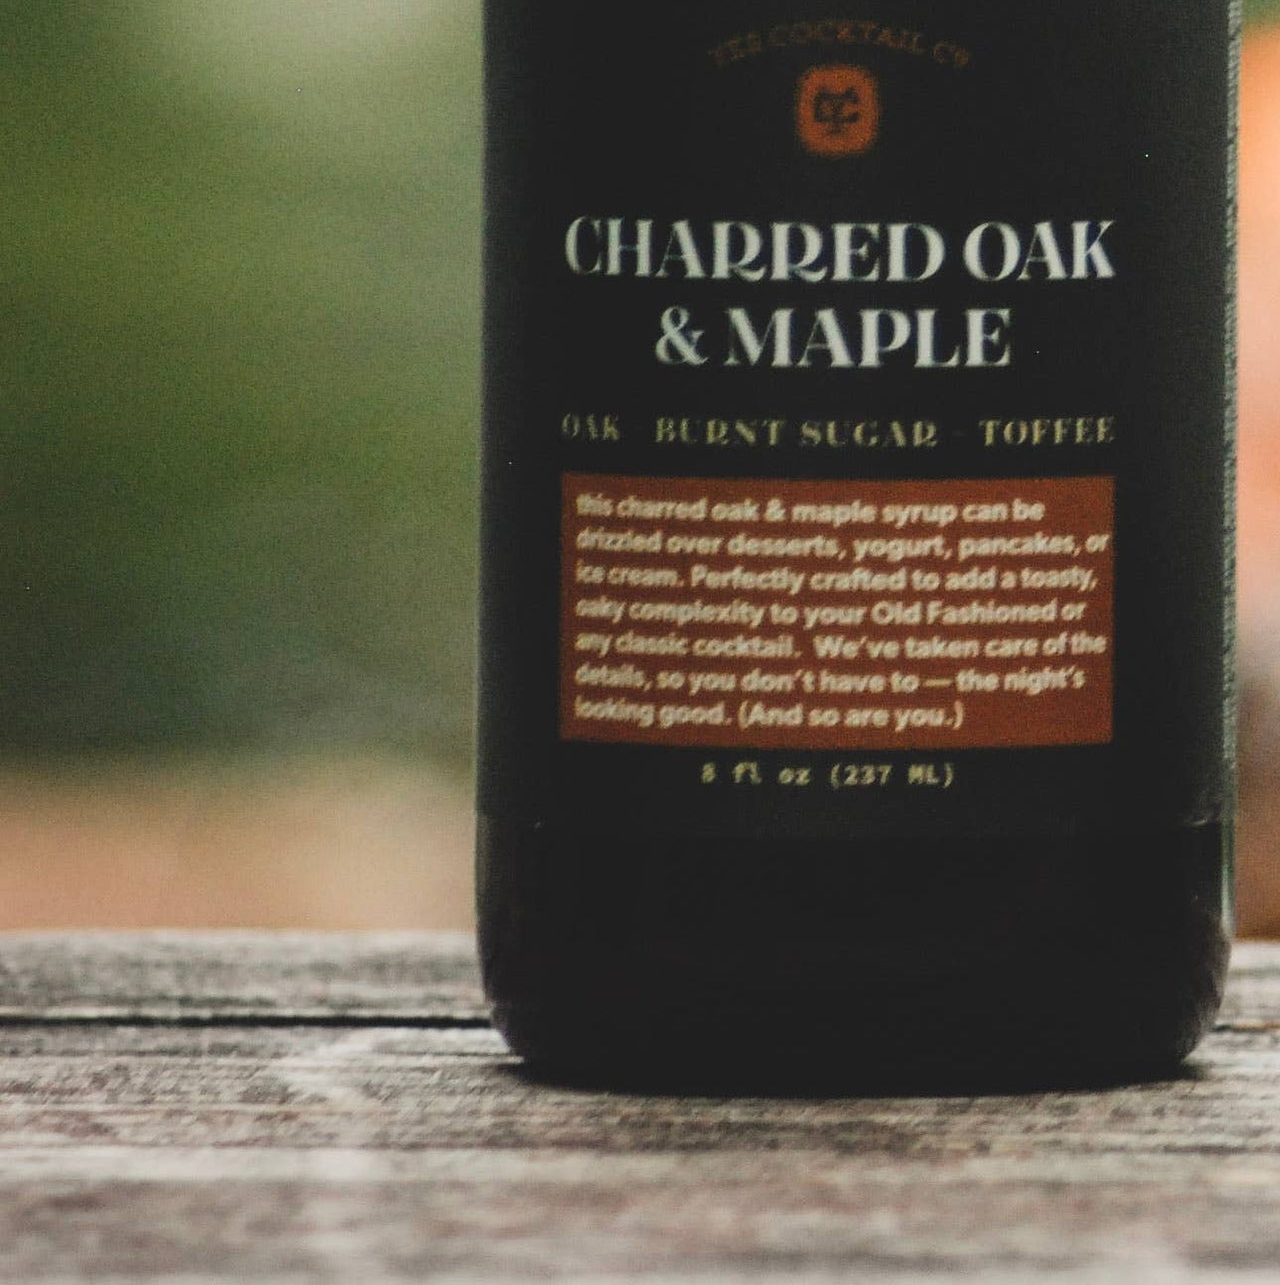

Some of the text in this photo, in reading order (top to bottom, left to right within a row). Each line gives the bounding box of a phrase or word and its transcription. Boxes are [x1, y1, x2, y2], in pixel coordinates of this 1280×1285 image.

[564, 216, 1115, 283] CHARRED OAK
[655, 306, 1011, 368] & MAPLE
[561, 413, 1115, 448] OAK BURNT SUGAR TOFFEE
[576, 493, 1045, 529] this charred oak & maple syrup can be
[576, 528, 1110, 562] drizzled over desserts, yogurt, pancakes, or
[576, 561, 1098, 594] ice cream. Perfectly crafted to add a toasty,
[629, 599, 765, 628] complexity
[769, 603, 798, 624] to
[803, 605, 867, 629] your
[871, 601, 922, 625] Old
[926, 598, 1057, 625] Fashioned
[1060, 602, 1087, 621] or
[575, 631, 1107, 659] any classic cocktail. We've taken care of the
[575, 663, 651, 692] details,
[656, 671, 686, 690] so
[688, 671, 737, 696] you
[740, 668, 816, 693] don't
[819, 669, 886, 693] have
[891, 671, 921, 693] to
[956, 667, 1000, 692] the
[1003, 665, 1086, 694] night's
[574, 696, 965, 732] looking good. (And so are you.)
[701, 763, 717, 784] 8
[777, 767, 811, 785] oz
[830, 763, 893, 789] (237
